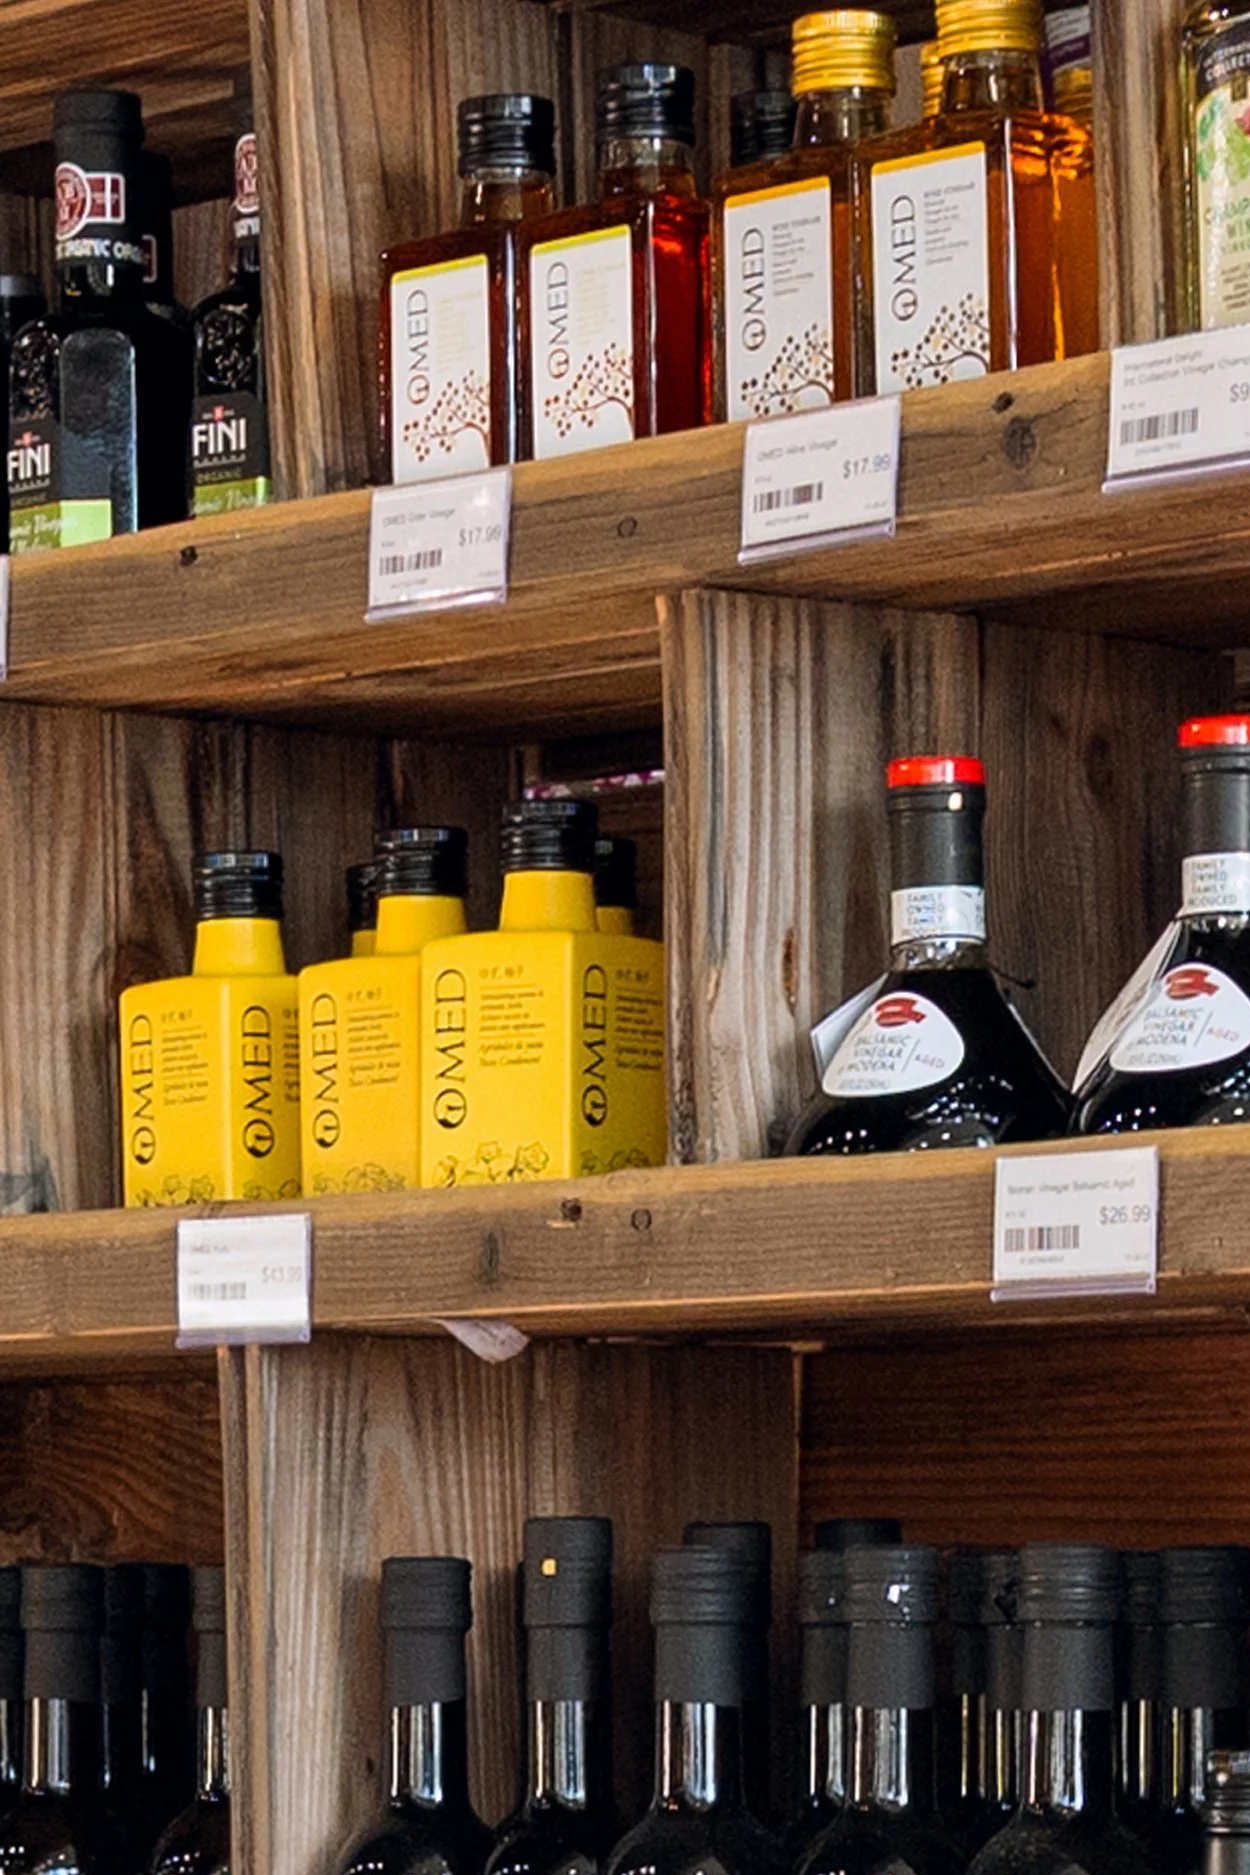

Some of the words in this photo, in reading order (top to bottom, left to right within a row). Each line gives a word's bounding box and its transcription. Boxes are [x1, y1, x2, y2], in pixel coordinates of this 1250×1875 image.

[742, 226, 767, 352] OMED
[891, 193, 917, 323] OMED
[405, 287, 430, 407] OMED
[546, 260, 571, 380] OMED
[7, 443, 51, 482] FINI
[192, 418, 247, 457] FINI
[842, 452, 891, 479] $17.99
[458, 523, 503, 547] $17.99
[130, 1014, 157, 1166] OMED
[241, 1005, 277, 1159] OMED
[310, 992, 342, 1150] OMED
[432, 968, 468, 1130] OMED
[581, 963, 610, 1129] OMED
[1099, 1204, 1151, 1226] $26.99
